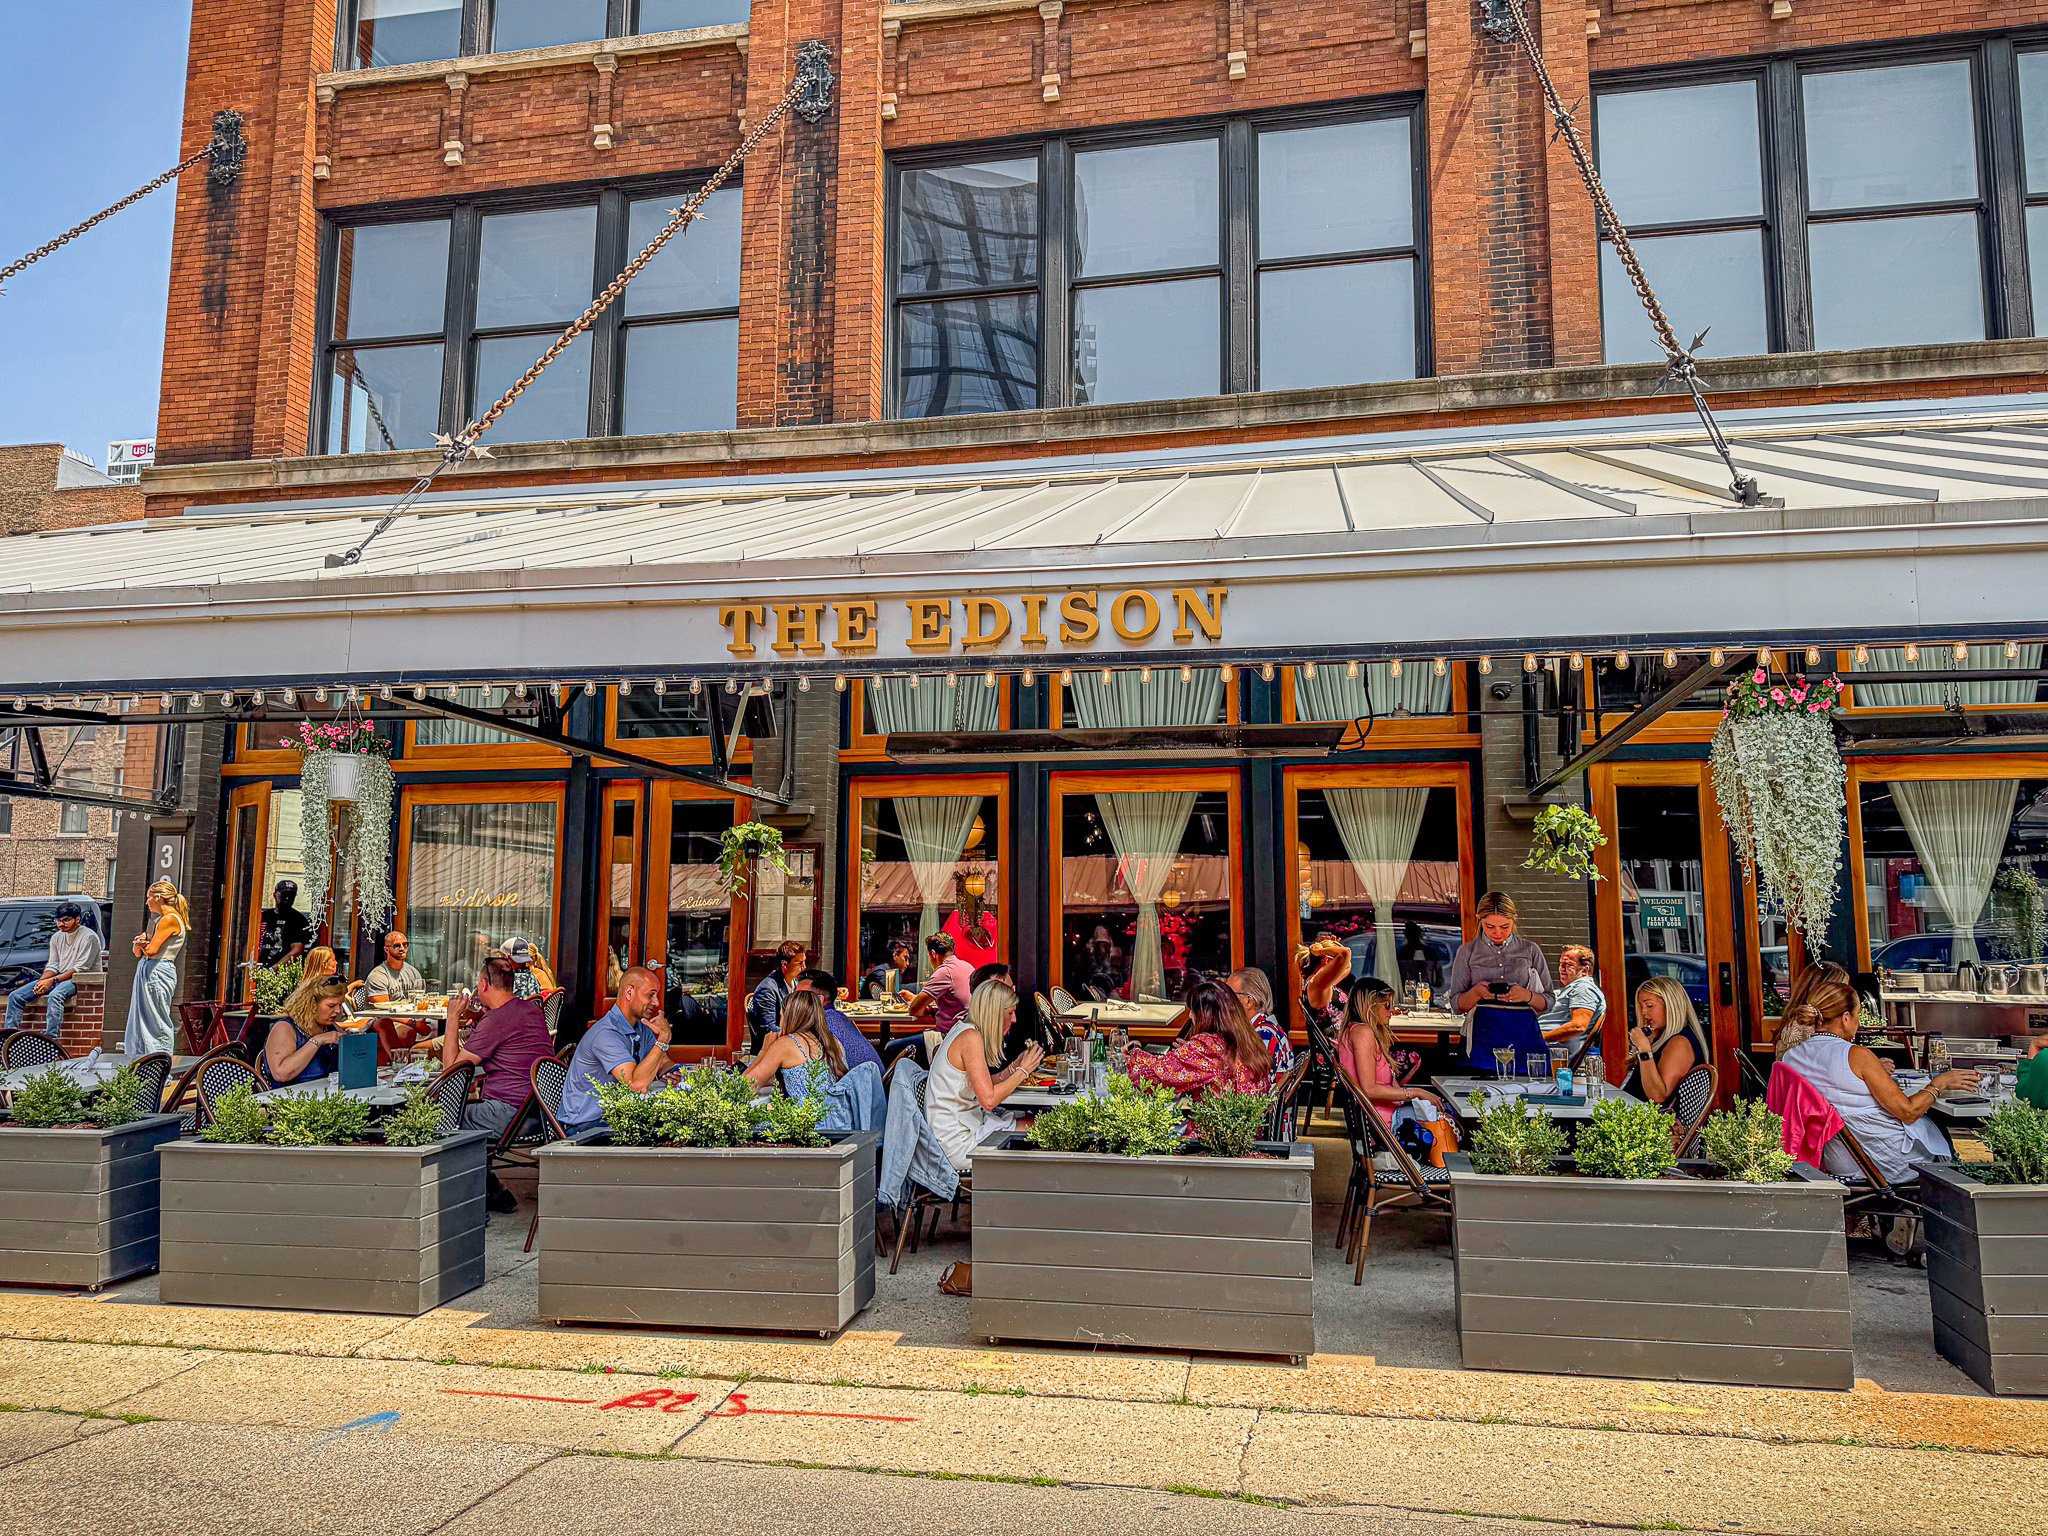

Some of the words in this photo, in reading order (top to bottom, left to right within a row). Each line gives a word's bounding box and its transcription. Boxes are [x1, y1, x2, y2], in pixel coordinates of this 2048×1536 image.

[718, 599, 878, 654] THE
[905, 586, 1229, 650] EDISON
[452, 888, 522, 912] Edison
[686, 895, 721, 909] Edison
